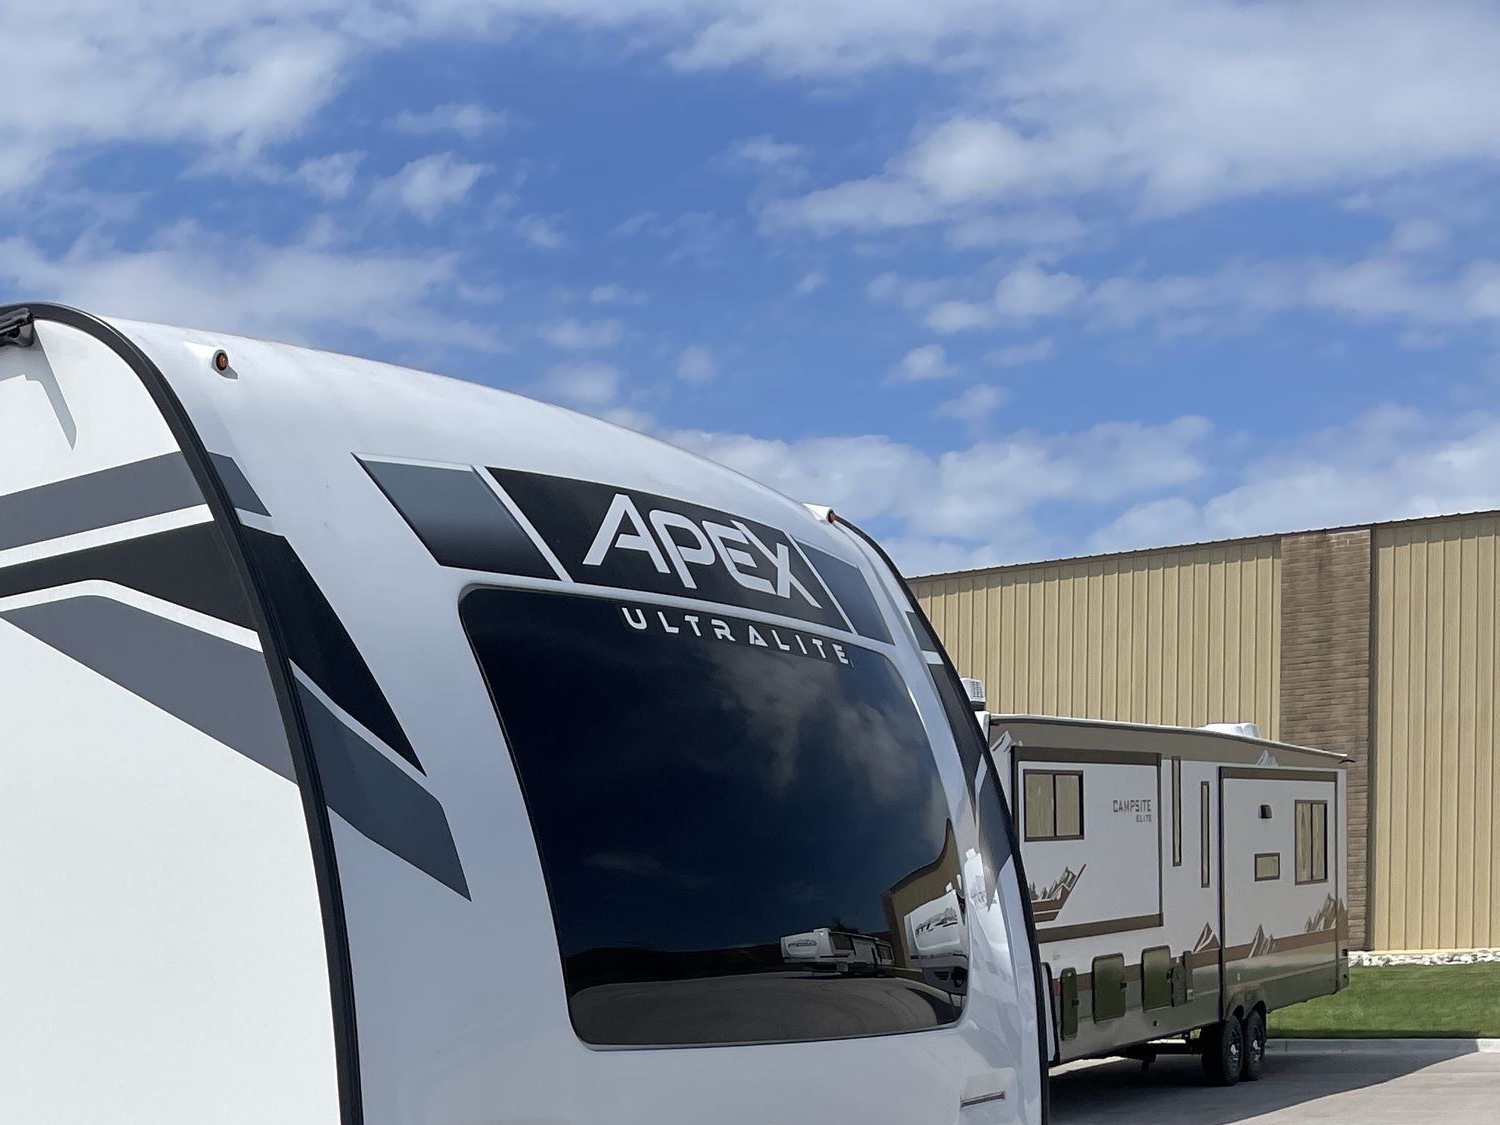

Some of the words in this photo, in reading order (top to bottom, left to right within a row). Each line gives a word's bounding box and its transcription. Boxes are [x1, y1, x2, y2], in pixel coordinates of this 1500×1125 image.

[583, 493, 822, 608] APEX
[622, 607, 849, 664] ULTRALITE
[1113, 799, 1151, 812] CAMPSITE
